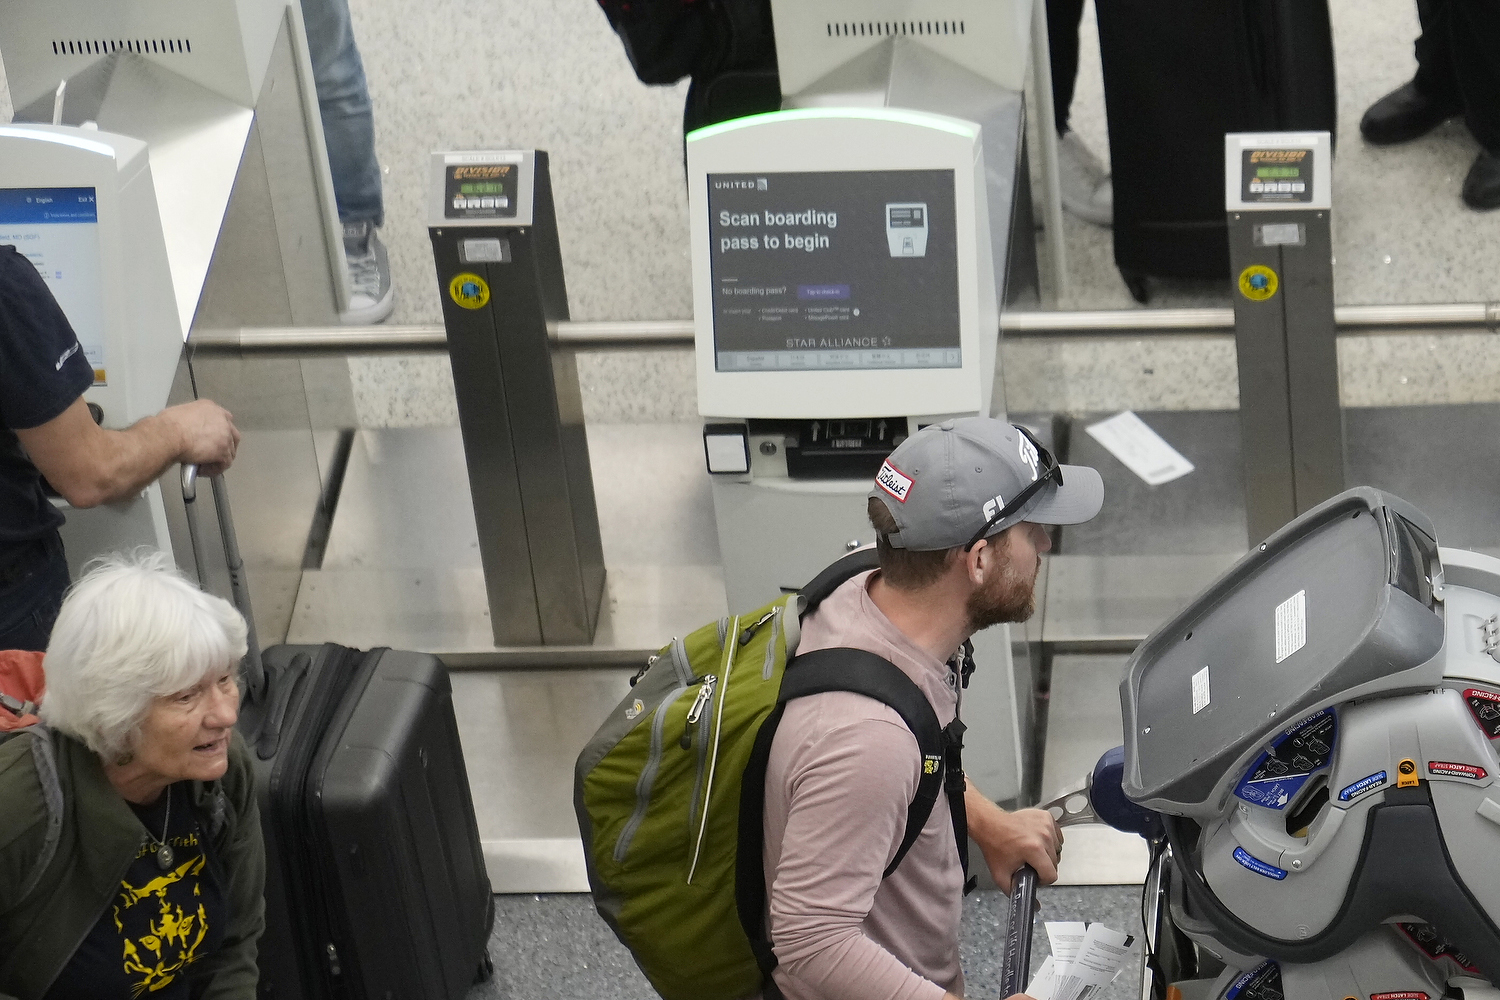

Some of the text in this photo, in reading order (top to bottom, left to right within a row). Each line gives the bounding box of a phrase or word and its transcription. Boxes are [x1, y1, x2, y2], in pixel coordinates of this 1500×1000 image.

[715, 181, 755, 189] UNITED
[719, 210, 837, 229] Scan boarding
[721, 233, 830, 253] pass to begin
[722, 286, 787, 296] No boarding pass?
[786, 337, 878, 348] STAR ALLIANCE
[877, 467, 907, 496] Titleist
[1433, 769, 1475, 778] FORWARD-FACING
[1351, 780, 1382, 797] REAR-FACING
[1357, 778, 1372, 789] LATCH
[1011, 893, 1021, 918] Press
[1004, 950, 1016, 984] Handle
